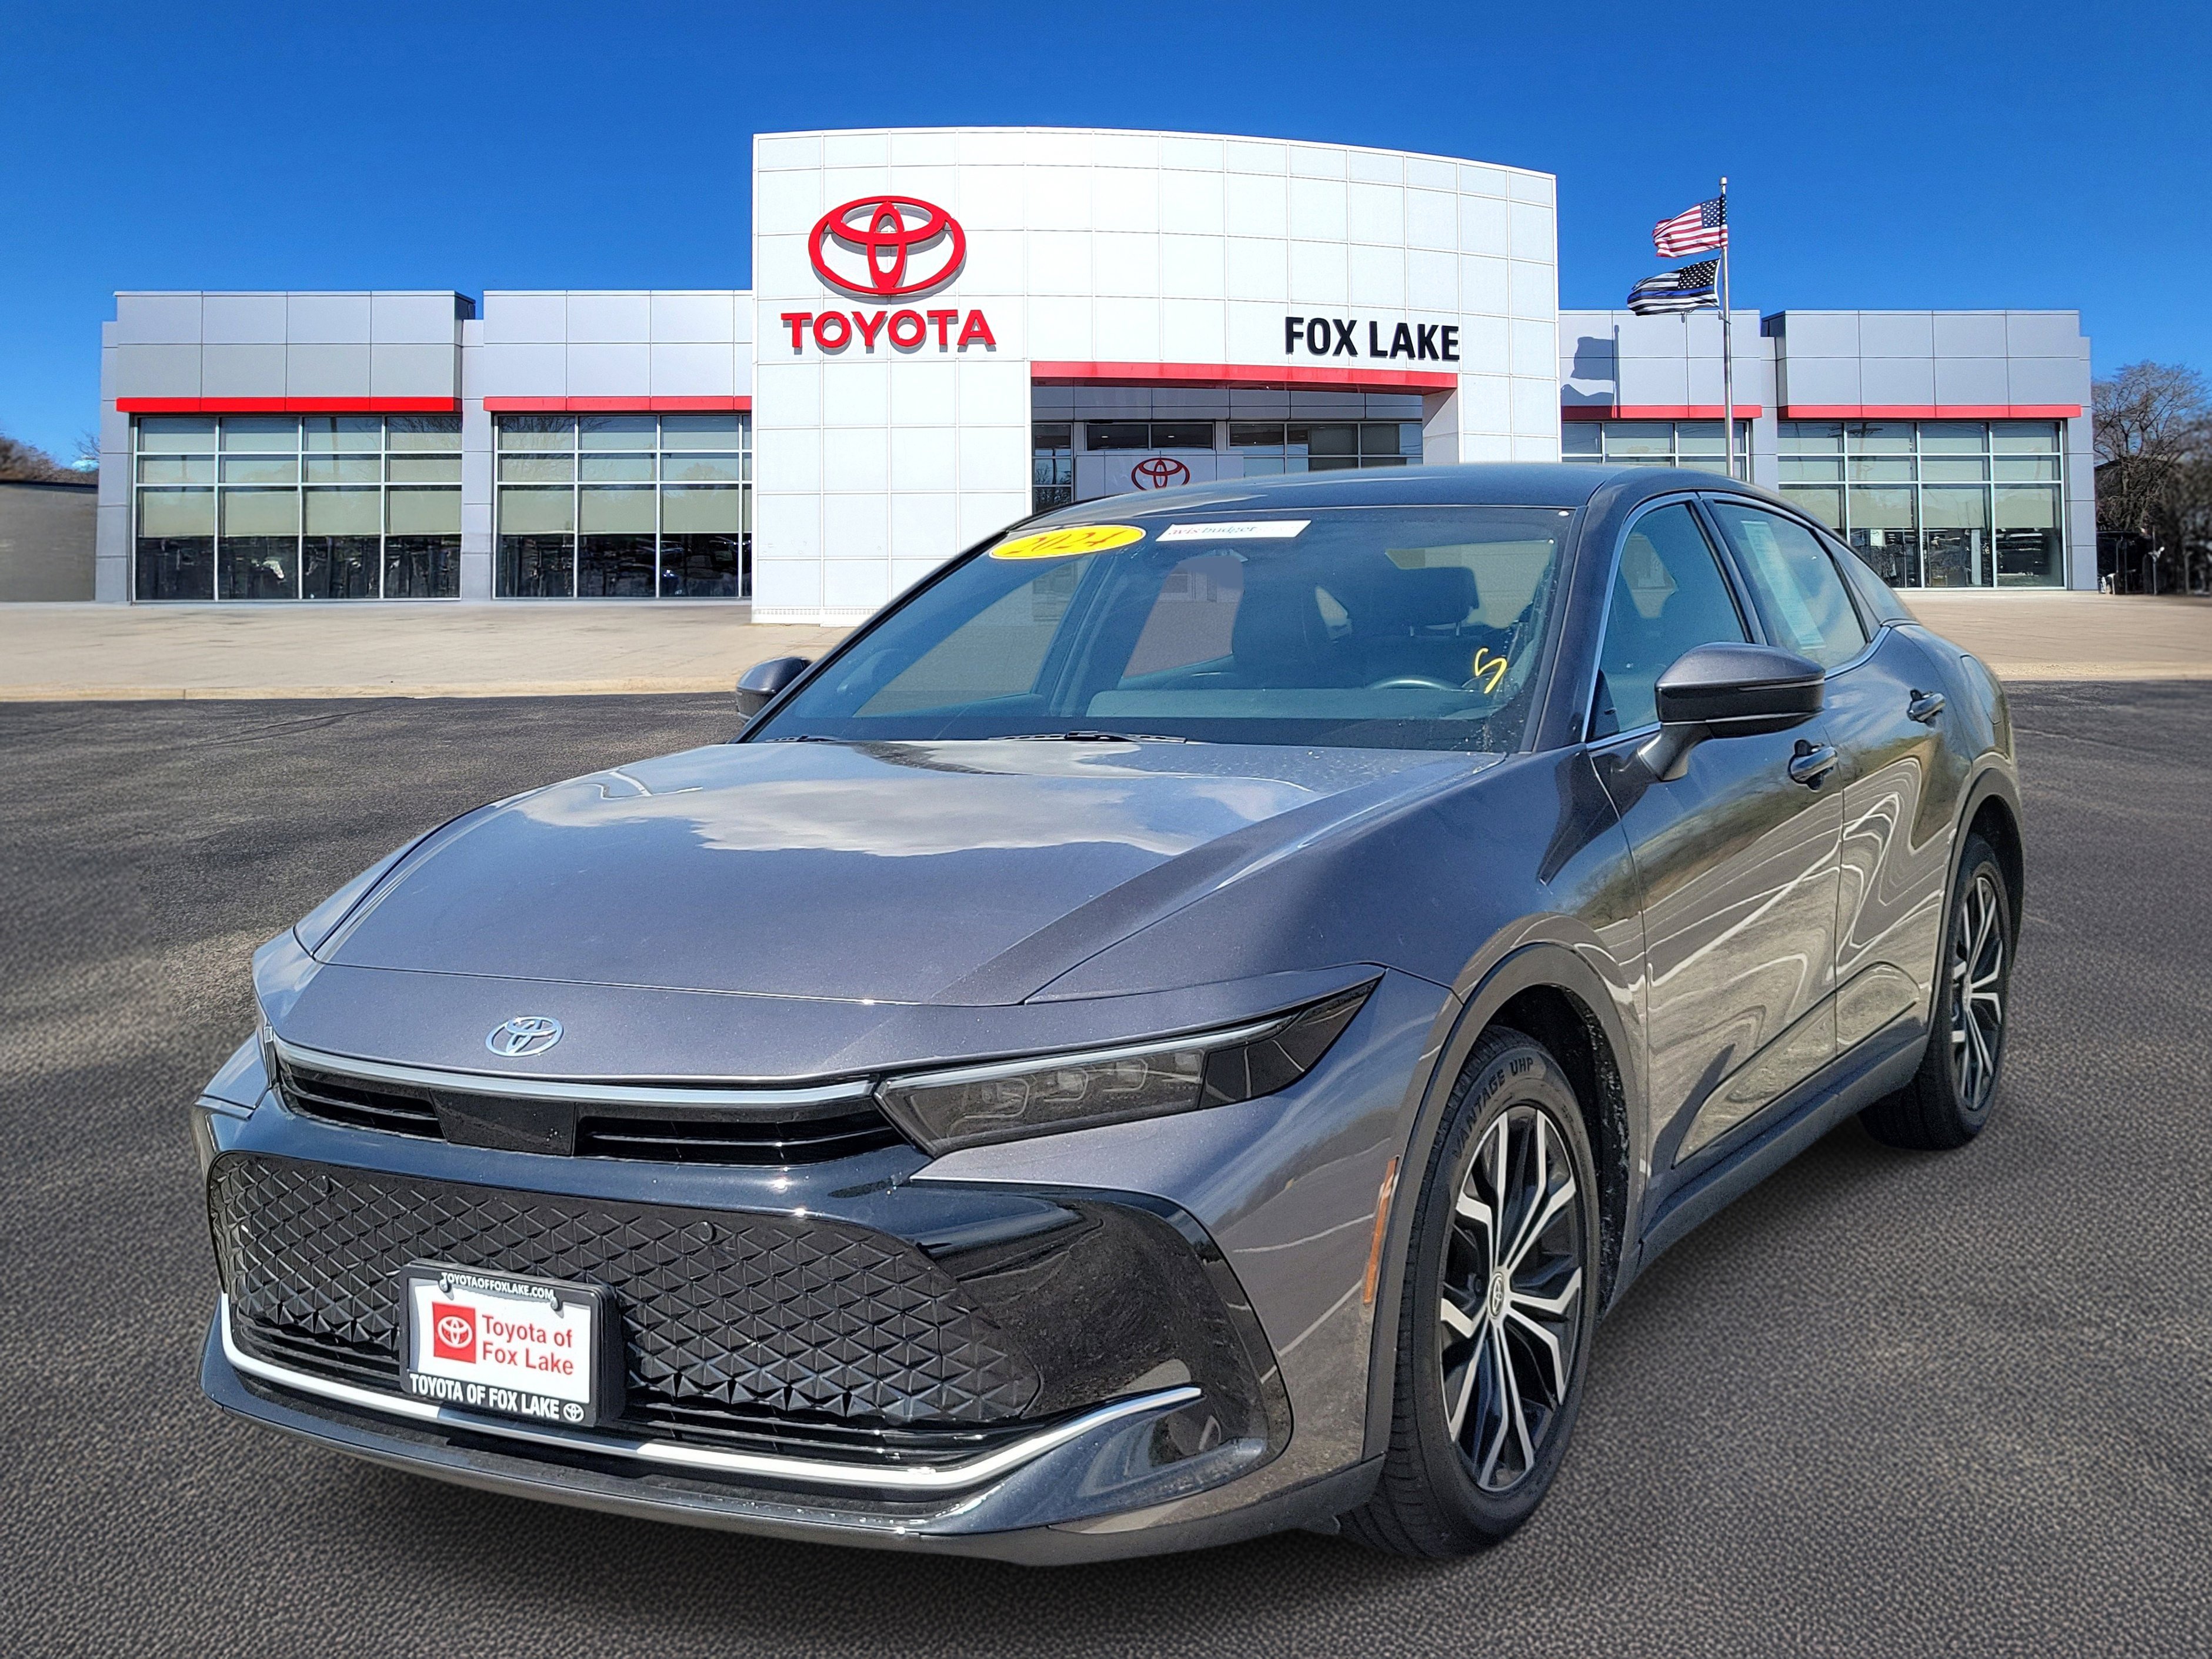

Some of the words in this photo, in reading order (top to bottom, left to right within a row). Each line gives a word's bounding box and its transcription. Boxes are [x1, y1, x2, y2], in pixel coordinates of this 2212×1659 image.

[780, 309, 996, 349] TOYOTA
[1285, 316, 1359, 357] FOX
[1369, 321, 1460, 361] LAKE
[1509, 1057, 1534, 1076] UHP
[441, 1272, 555, 1300] TOYOTAOFFOXLAKE.COM
[482, 1314, 546, 1344] Toyota
[553, 1328, 573, 1348] of
[482, 1341, 518, 1366] Fox
[525, 1348, 574, 1375] Lake
[409, 1374, 463, 1403] TOYOTA
[466, 1383, 486, 1405] OF
[489, 1387, 518, 1413] FOX
[521, 1393, 560, 1420] LAKE
